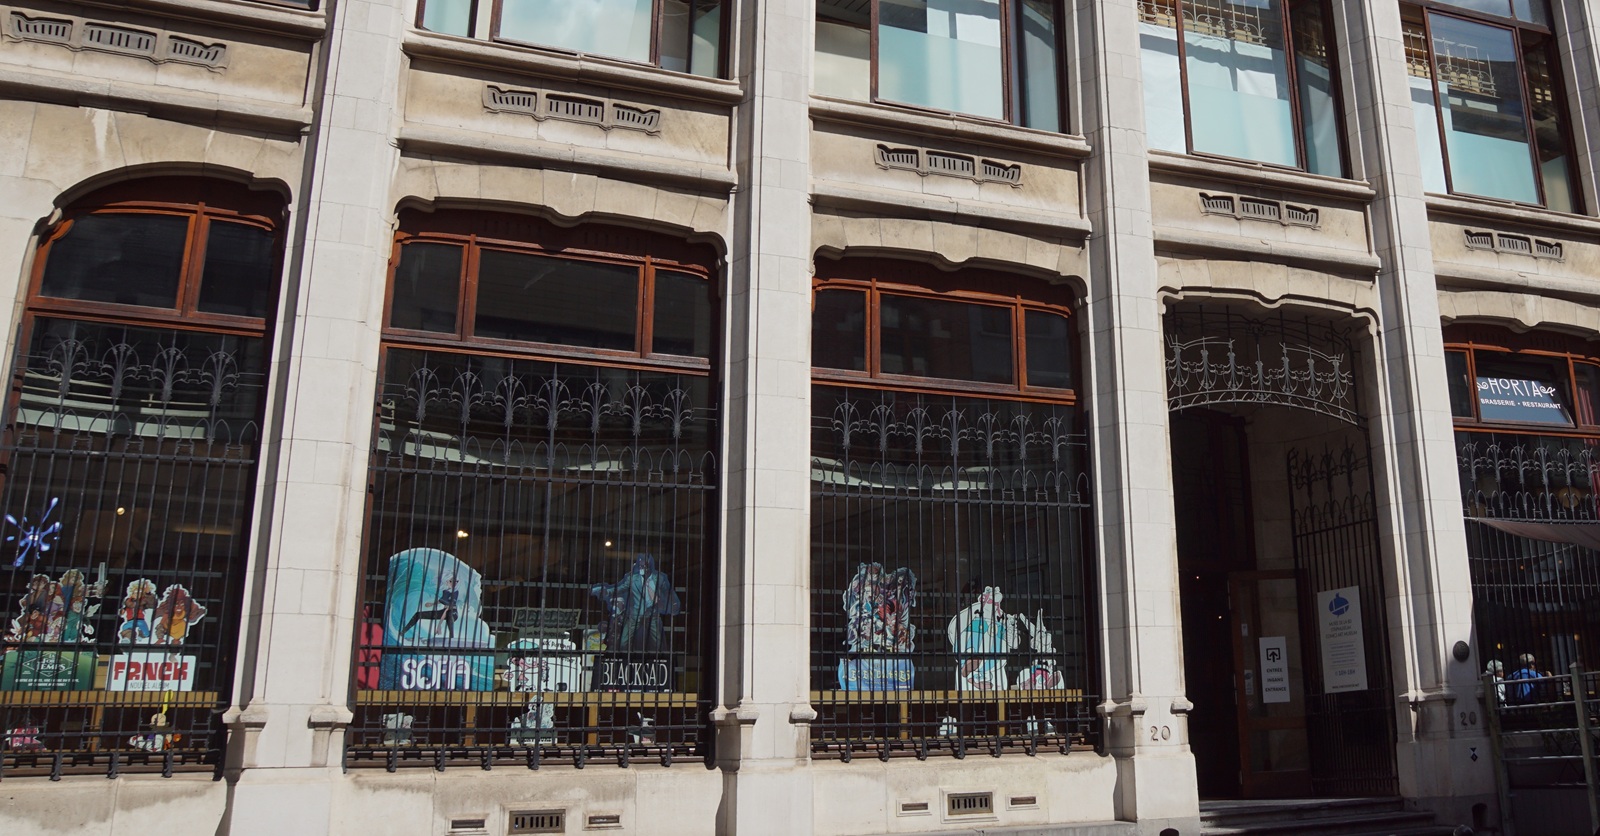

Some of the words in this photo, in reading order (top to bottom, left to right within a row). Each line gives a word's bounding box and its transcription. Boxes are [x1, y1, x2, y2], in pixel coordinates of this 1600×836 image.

[1487, 377, 1543, 398] HORTA
[1480, 398, 1516, 407] BRASSERIE
[1521, 401, 1562, 410] RESTAURANT
[600, 661, 668, 687] BLACKSAD
[1460, 711, 1477, 726] 20
[1150, 725, 1171, 742] 20
